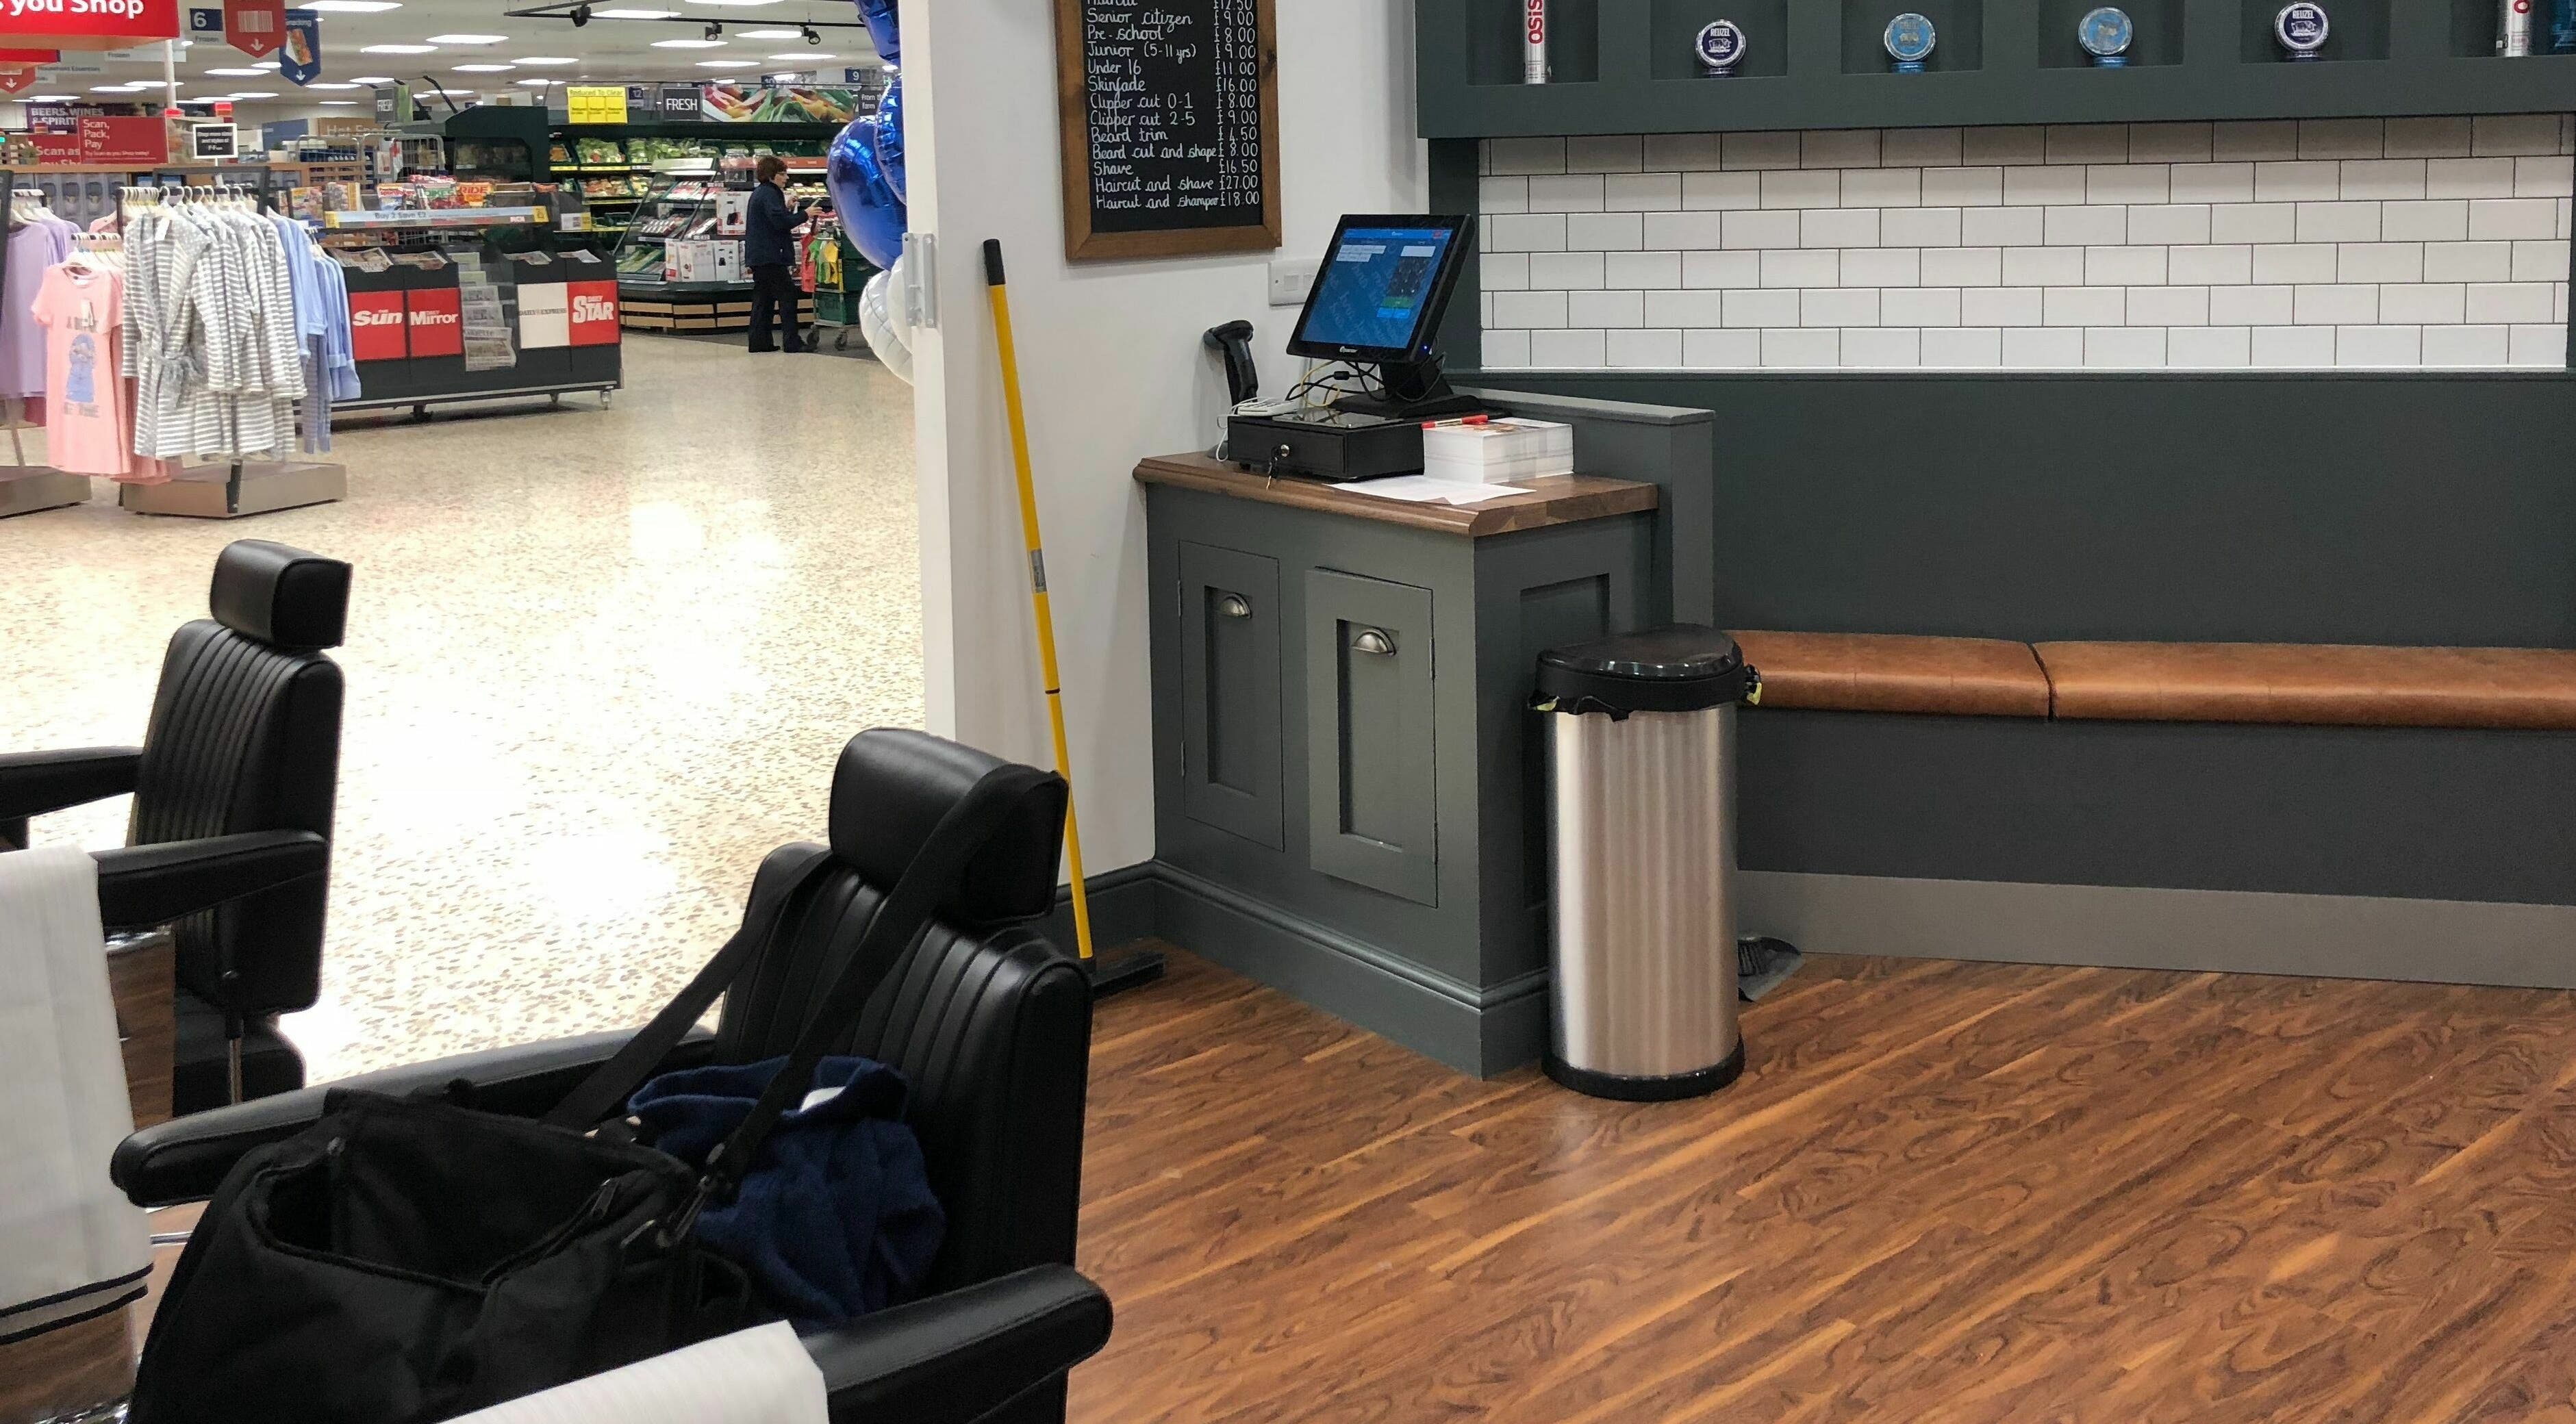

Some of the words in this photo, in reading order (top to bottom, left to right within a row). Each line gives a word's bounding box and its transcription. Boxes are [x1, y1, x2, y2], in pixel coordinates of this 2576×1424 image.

[71, 0, 144, 19] Shop
[194, 12, 207, 27] 6
[1087, 8, 1133, 23] Senior
[1141, 8, 1194, 33] citizen
[1087, 41, 1134, 57] Junior
[1088, 60, 1122, 75] Under
[1128, 60, 1141, 75] 16
[1215, 60, 1256, 75] £11.00
[853, 71, 859, 81] 9
[1088, 76, 1146, 97] Skinfade
[1216, 77, 1257, 92] £16.00
[666, 99, 698, 110] FRESH
[1090, 94, 1133, 114] Clipper
[1137, 94, 1161, 108] cut
[1168, 92, 1194, 109] 0-1
[70, 107, 104, 116] WINES
[44, 117, 78, 125] SPIRIT
[83, 118, 110, 129] Scan,
[1090, 110, 1135, 132] Clipper
[1139, 112, 1161, 125] cut
[1170, 111, 1196, 125] 2-5
[84, 129, 110, 139] Pack,
[1091, 127, 1131, 142] Beard
[1139, 127, 1168, 142] trim
[36, 146, 66, 155] Scan
[85, 139, 103, 150] Pay
[1092, 143, 1126, 160] Beard
[1131, 143, 1155, 158] cut
[1160, 142, 1183, 158] and
[1187, 144, 1217, 162] shape
[1094, 159, 1134, 175] Shave
[1219, 158, 1258, 174] £16.50
[1096, 176, 1141, 192] Haircut
[1145, 175, 1172, 192] and
[1178, 176, 1214, 190] shave
[1219, 175, 1258, 190] £27.00
[1096, 194, 1141, 209] Haircut
[1146, 193, 1170, 208] and
[1220, 191, 1260, 207] £18.00
[572, 296, 614, 323] STAR
[352, 310, 403, 326] Sun
[409, 311, 459, 326] Mirror
